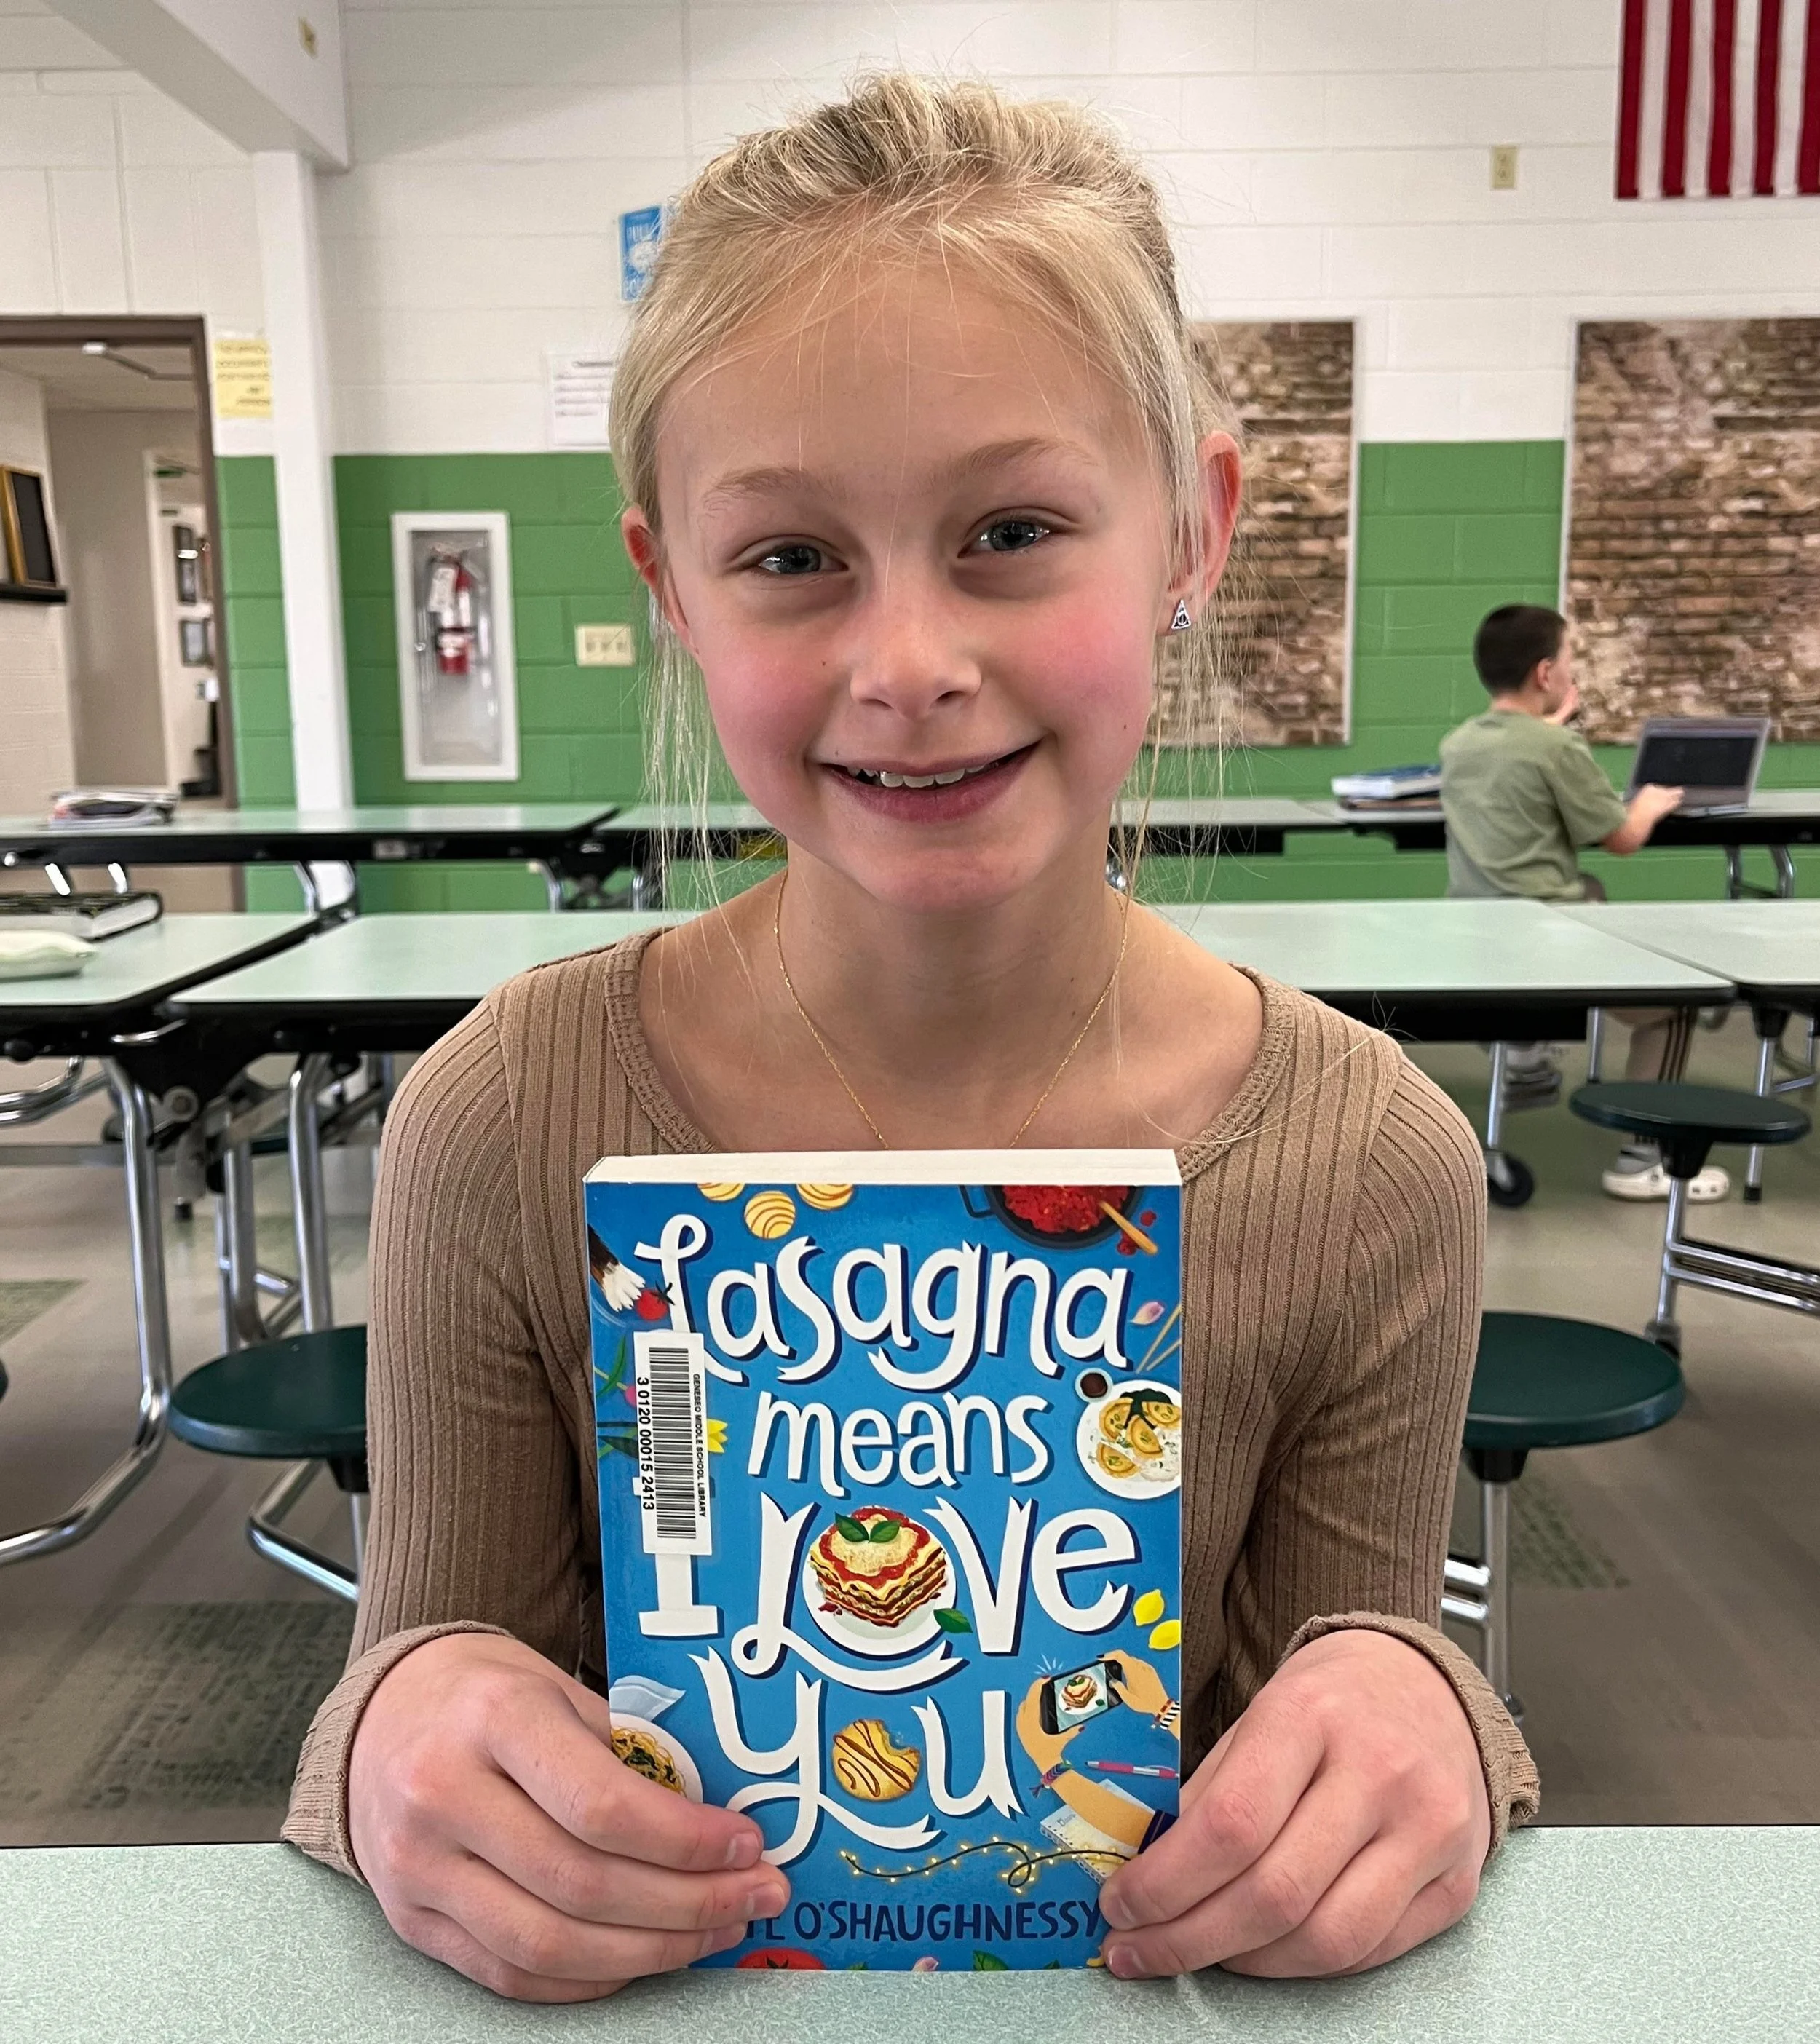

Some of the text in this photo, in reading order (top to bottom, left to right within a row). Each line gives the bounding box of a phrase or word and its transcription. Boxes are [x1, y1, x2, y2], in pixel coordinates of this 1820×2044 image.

[634, 1214, 1128, 1390] Lasagna
[637, 1376, 655, 1510] 3 0120 00015 2413
[692, 1374, 706, 1518] GENESEO MIDDLE SCHOOL LIBRARY
[748, 1391, 1048, 1497] means
[794, 1898, 1101, 1942] O'SHAUGHNESSY
